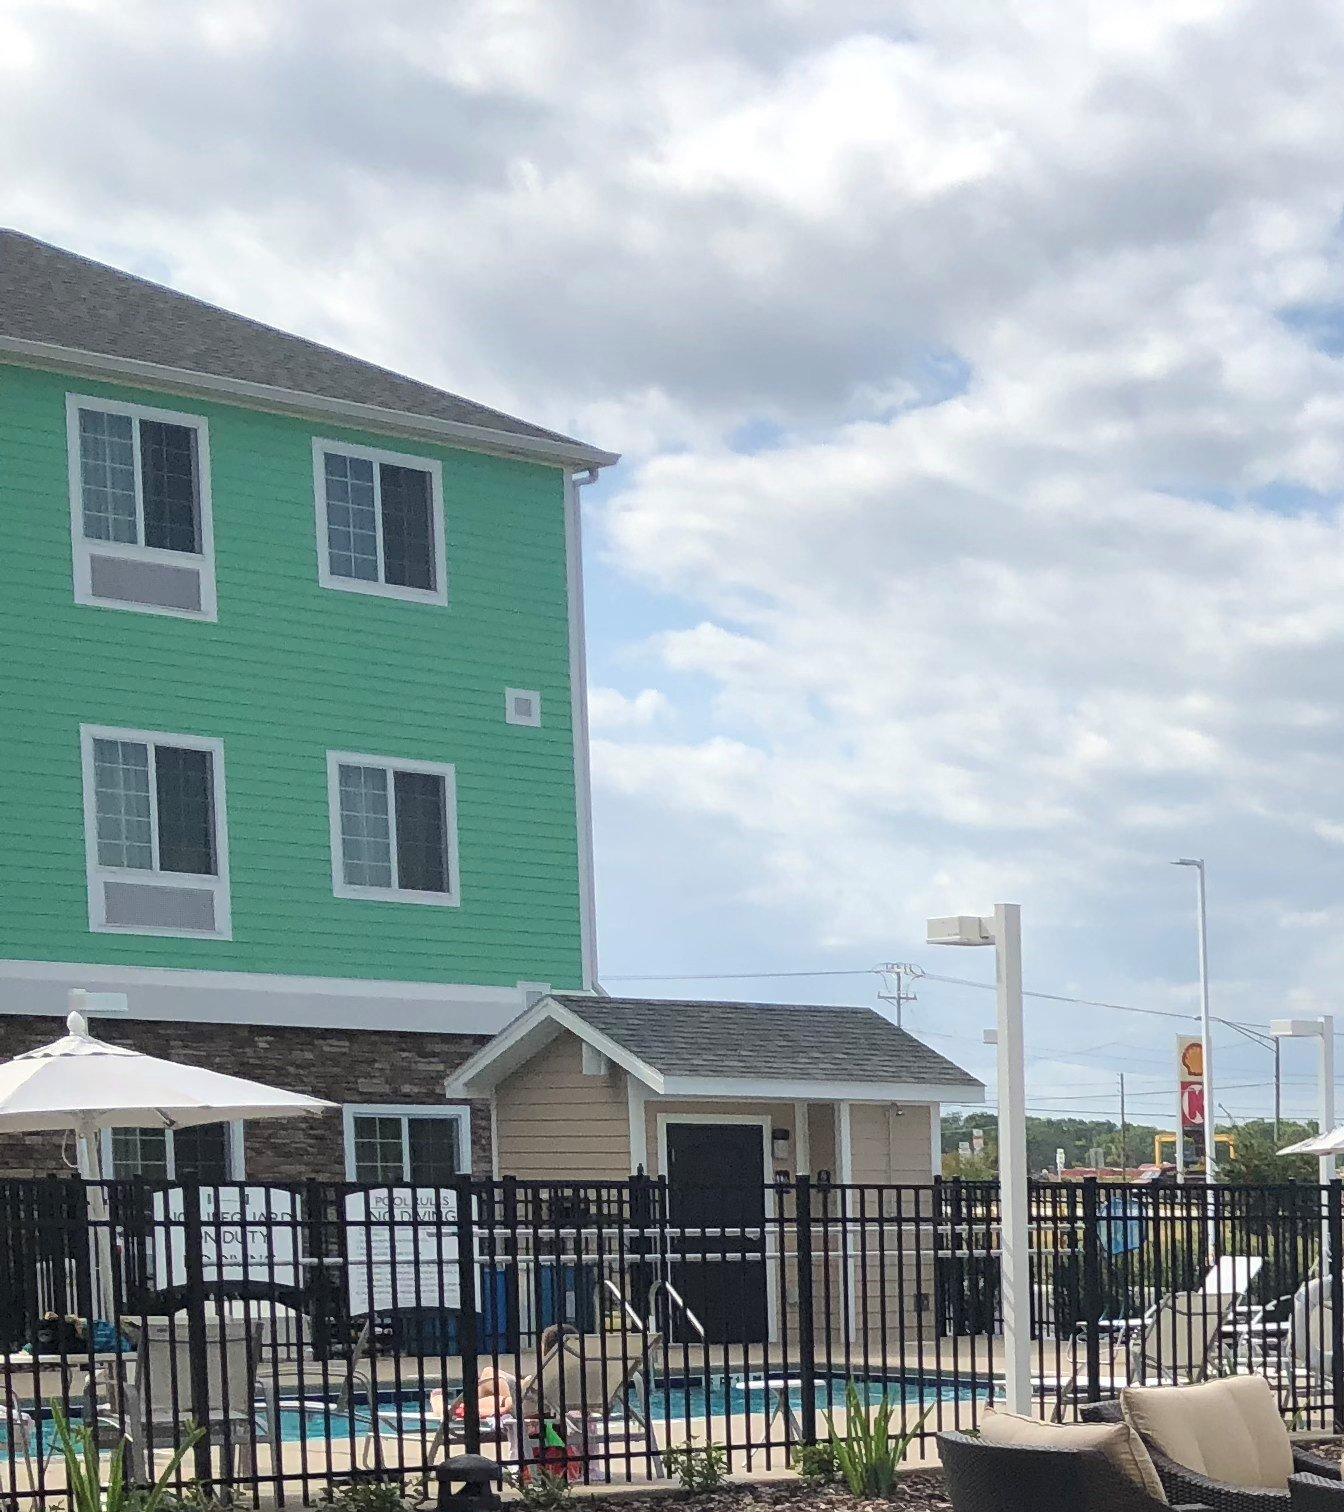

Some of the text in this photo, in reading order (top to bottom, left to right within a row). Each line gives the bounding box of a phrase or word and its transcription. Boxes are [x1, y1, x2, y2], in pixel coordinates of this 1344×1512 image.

[375, 1196, 450, 1207] POOL ULS
[400, 1209, 457, 1223] DVIG
[223, 1230, 270, 1245] DUTY
